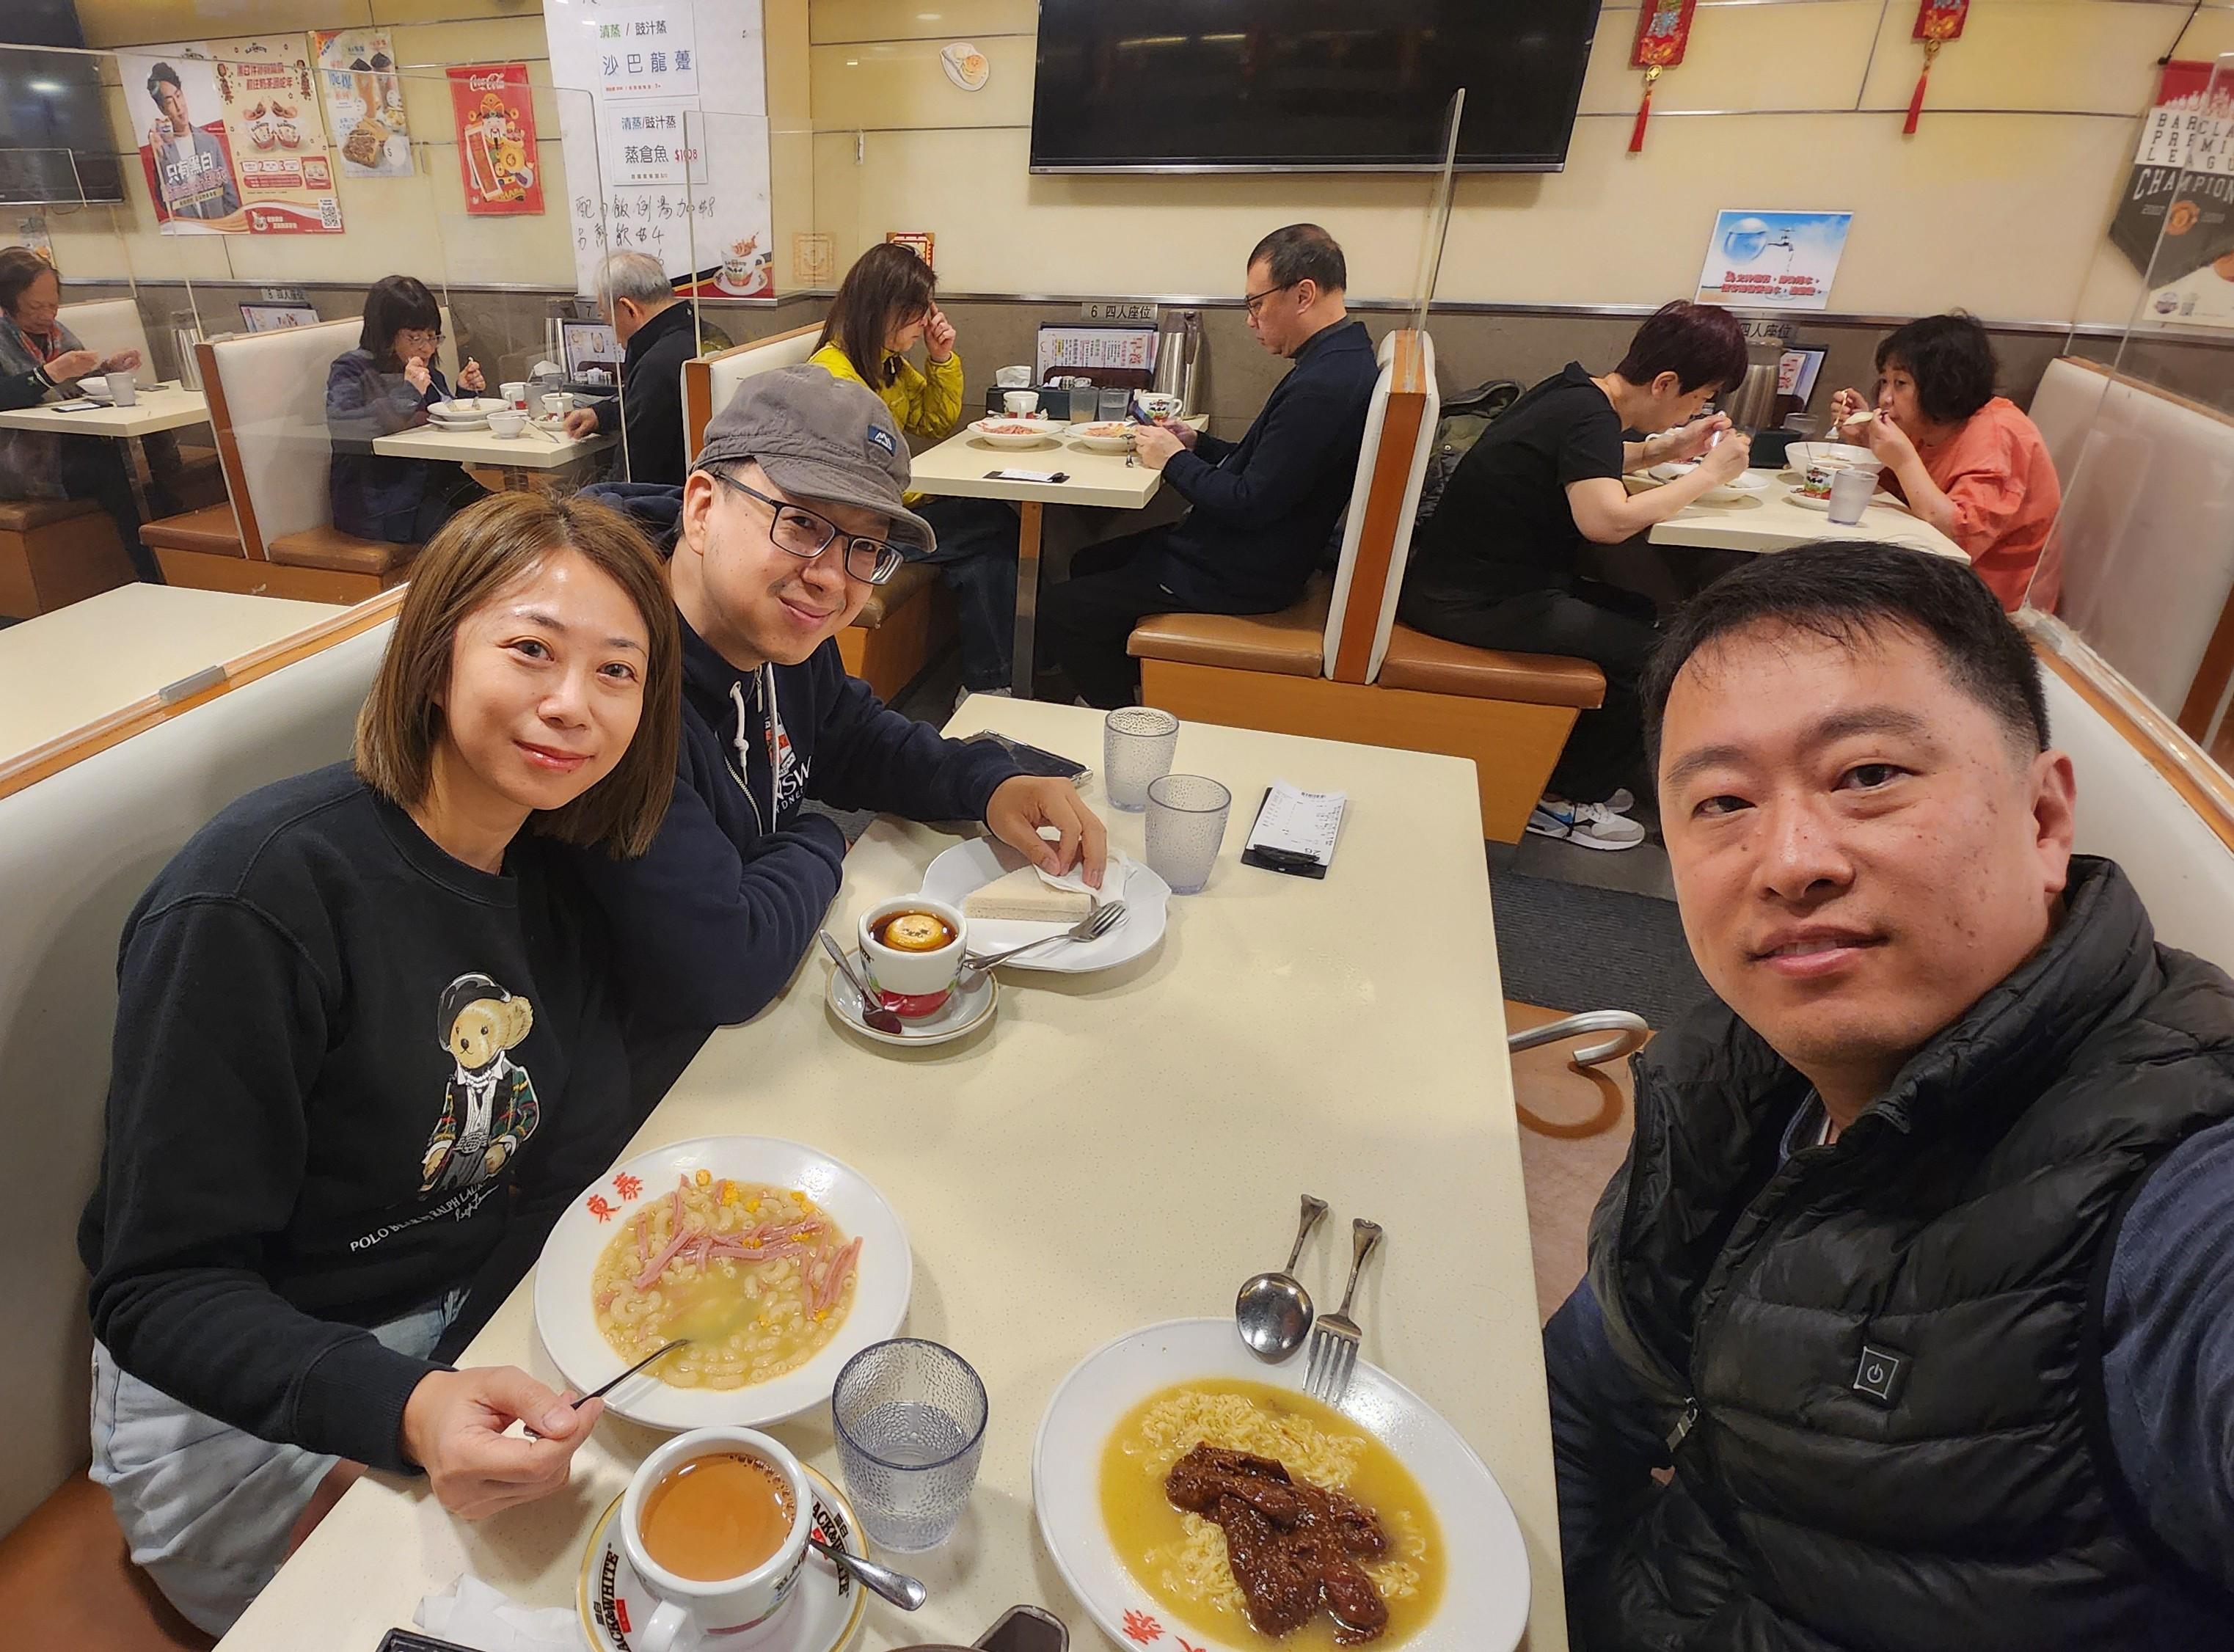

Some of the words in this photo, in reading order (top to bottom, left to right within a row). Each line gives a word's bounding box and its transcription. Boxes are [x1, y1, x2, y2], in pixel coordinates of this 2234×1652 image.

[599, 24, 621, 37] 清蒸
[635, 21, 667, 35] 豉汁蒸
[624, 145, 669, 164] 蒸倉魚
[166, 152, 213, 183] 只有黑白
[1091, 306, 1098, 318] 6
[1106, 305, 1151, 319] 四人座位
[1740, 323, 1793, 338] 四人座位
[350, 1227, 390, 1251] POLO
[428, 1196, 460, 1218] RALPH
